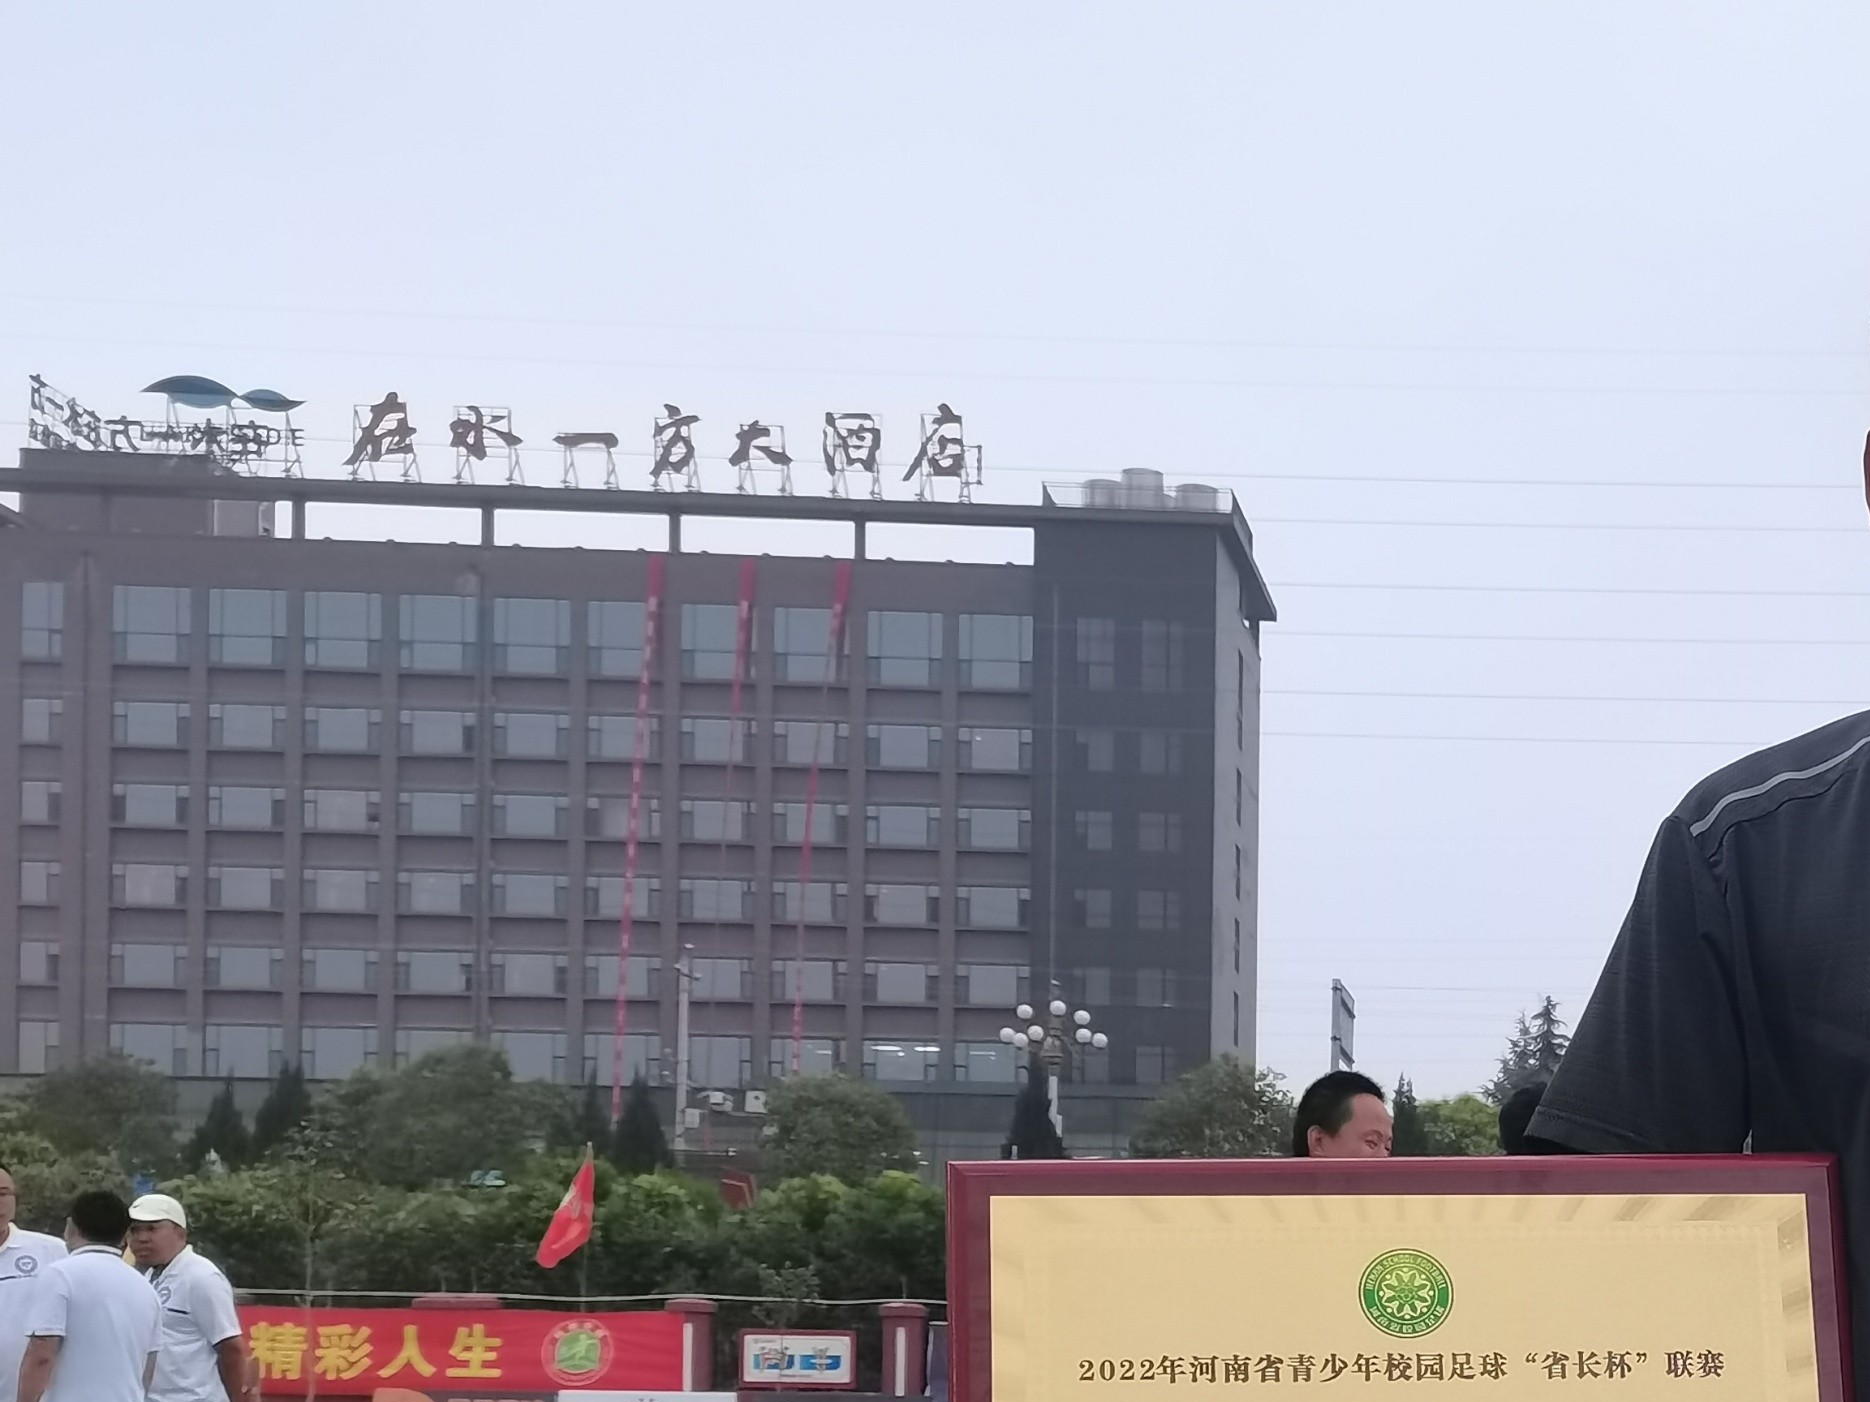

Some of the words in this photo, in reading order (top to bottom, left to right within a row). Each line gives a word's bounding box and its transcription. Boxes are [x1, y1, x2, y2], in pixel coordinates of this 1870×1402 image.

[343, 392, 966, 481] 在水一方大酒店
[249, 1321, 502, 1380] 精彩人生
